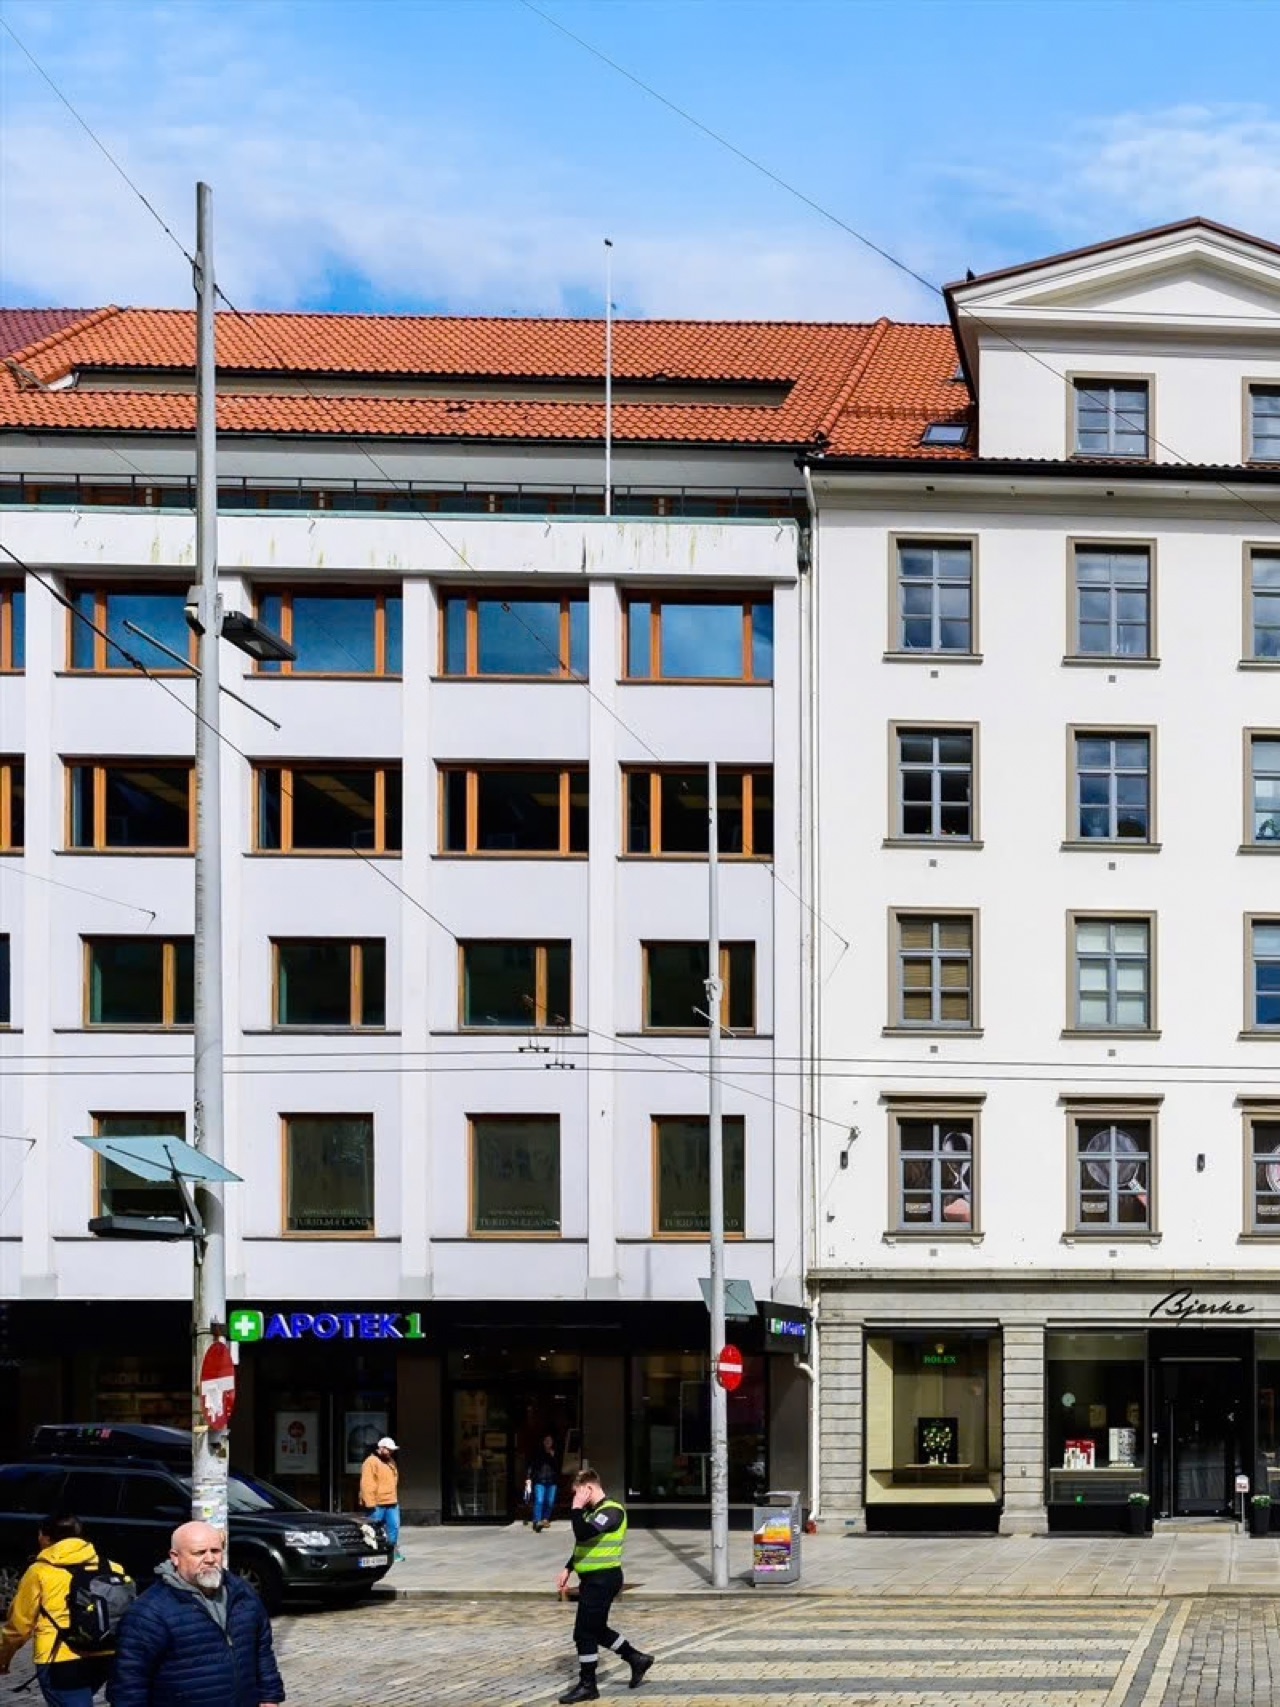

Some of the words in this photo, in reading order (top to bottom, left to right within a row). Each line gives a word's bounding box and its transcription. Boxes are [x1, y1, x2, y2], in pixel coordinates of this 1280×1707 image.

[1149, 1287, 1255, 1327] Bjerke
[265, 1313, 404, 1338] APOTEK
[405, 1312, 426, 1338] 1
